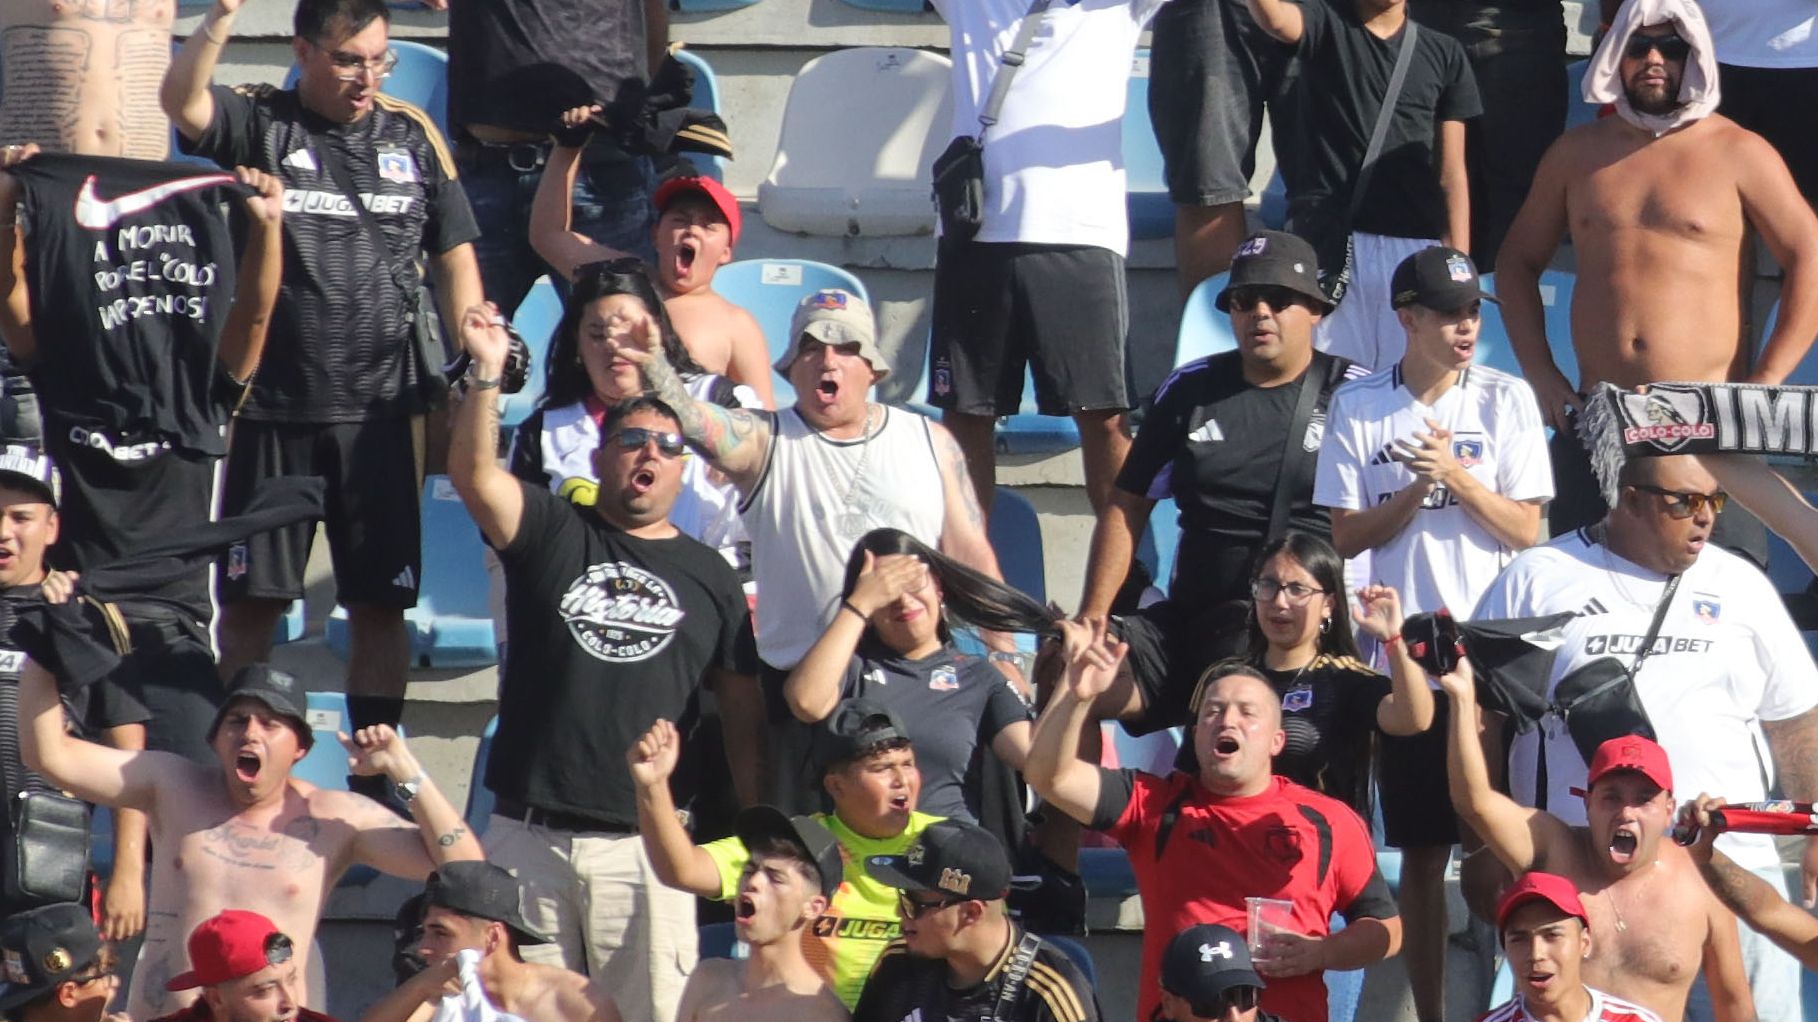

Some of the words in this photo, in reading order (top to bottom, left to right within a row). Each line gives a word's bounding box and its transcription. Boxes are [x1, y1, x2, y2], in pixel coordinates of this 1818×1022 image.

[118, 224, 196, 251] MORIR
[1628, 424, 1712, 443] COLO-COLO
[581, 630, 651, 658] COLO-COLO
[1610, 635, 1715, 654] JUABET
